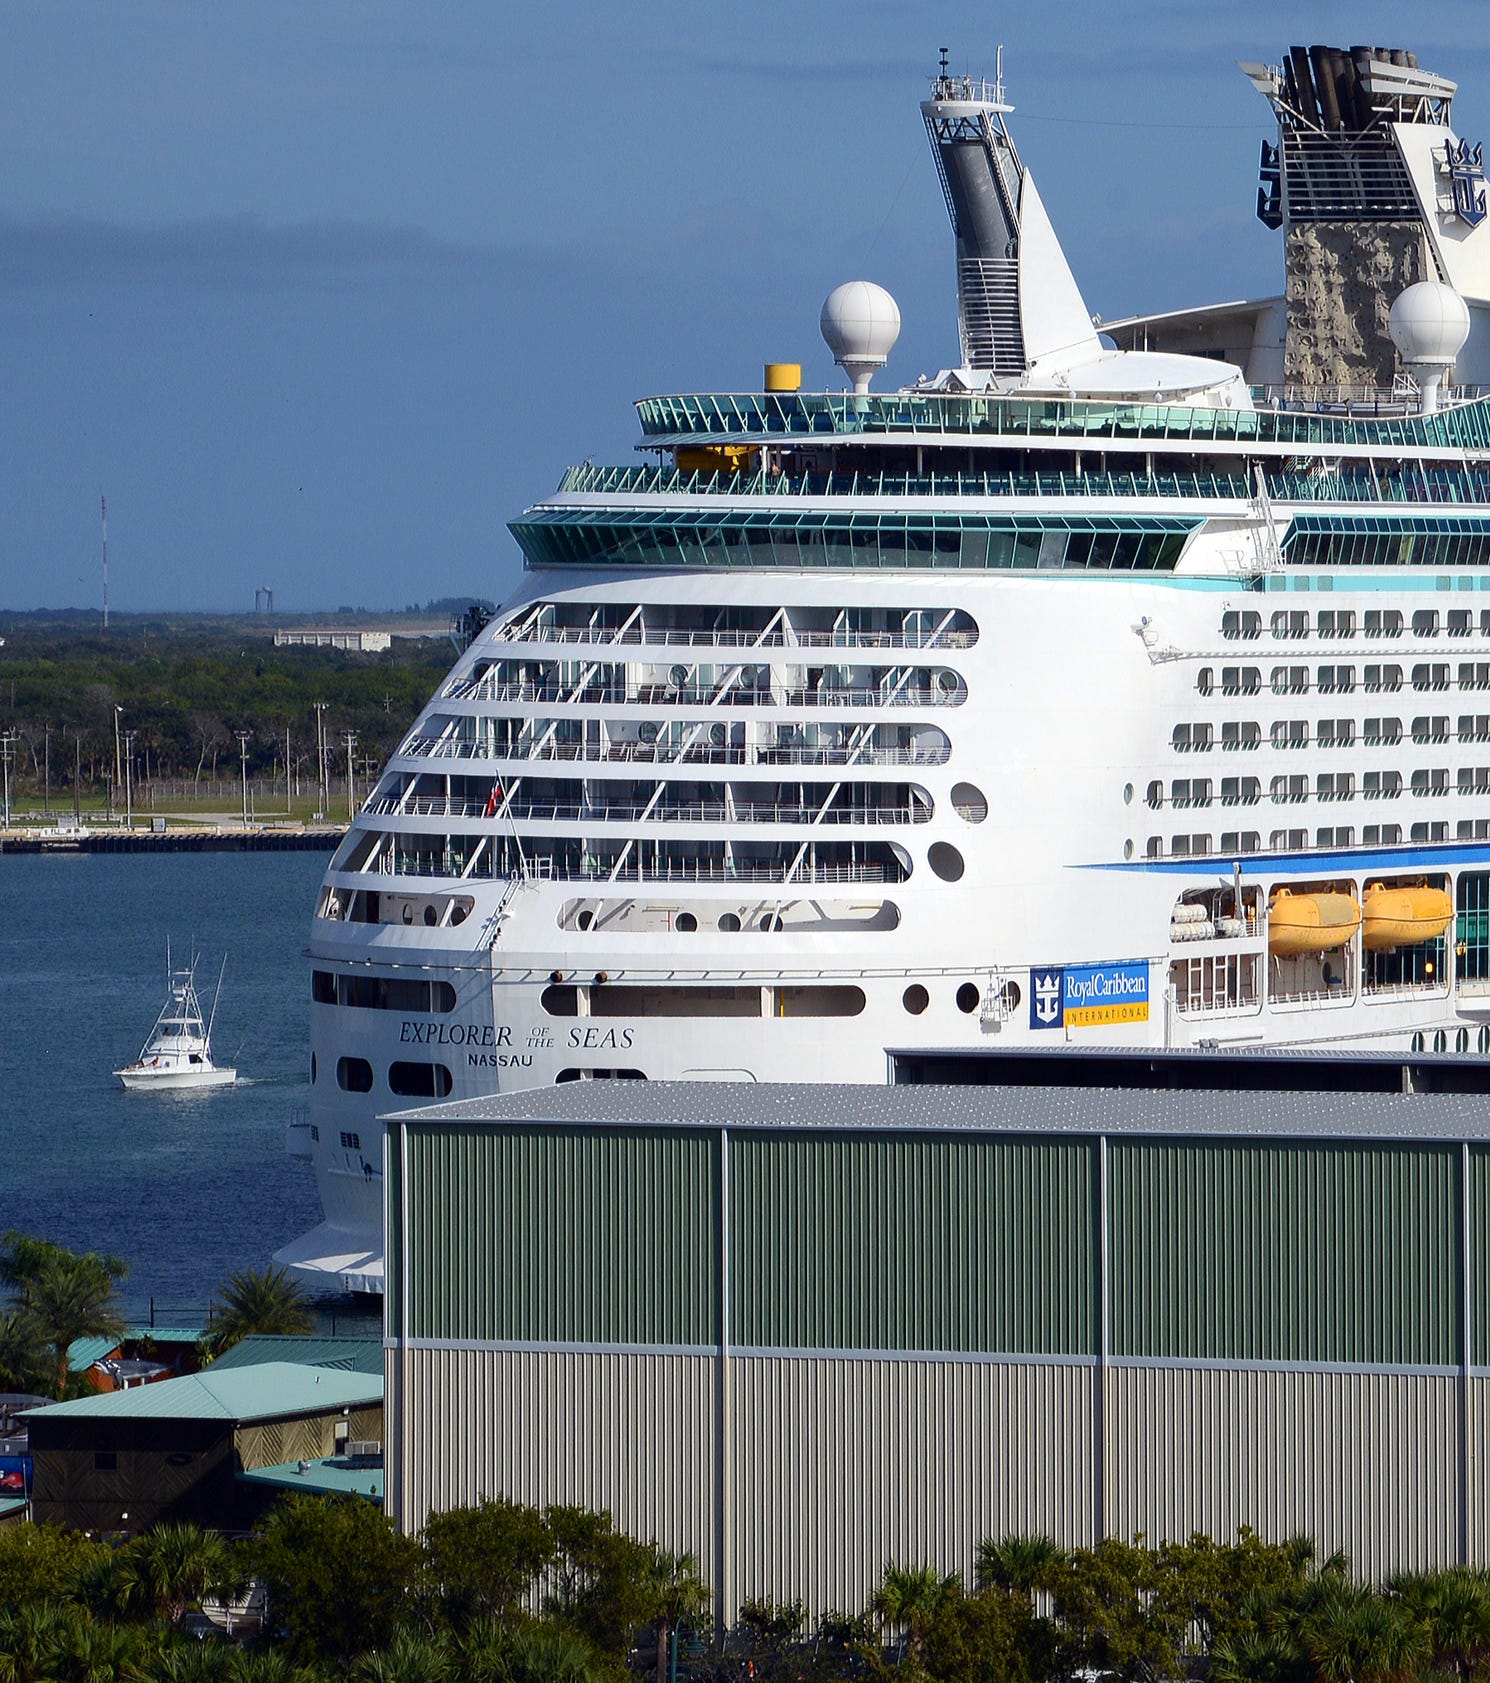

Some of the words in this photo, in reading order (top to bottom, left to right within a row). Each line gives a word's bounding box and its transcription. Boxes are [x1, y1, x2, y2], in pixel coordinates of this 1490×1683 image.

[1066, 1007, 1147, 1023] INTERNATIONAL
[400, 1022, 513, 1047] EXPLORER
[531, 1027, 550, 1038] OF
[567, 1027, 635, 1049] SEAS
[525, 1037, 555, 1048] THE
[468, 1053, 533, 1067] NASSAU
